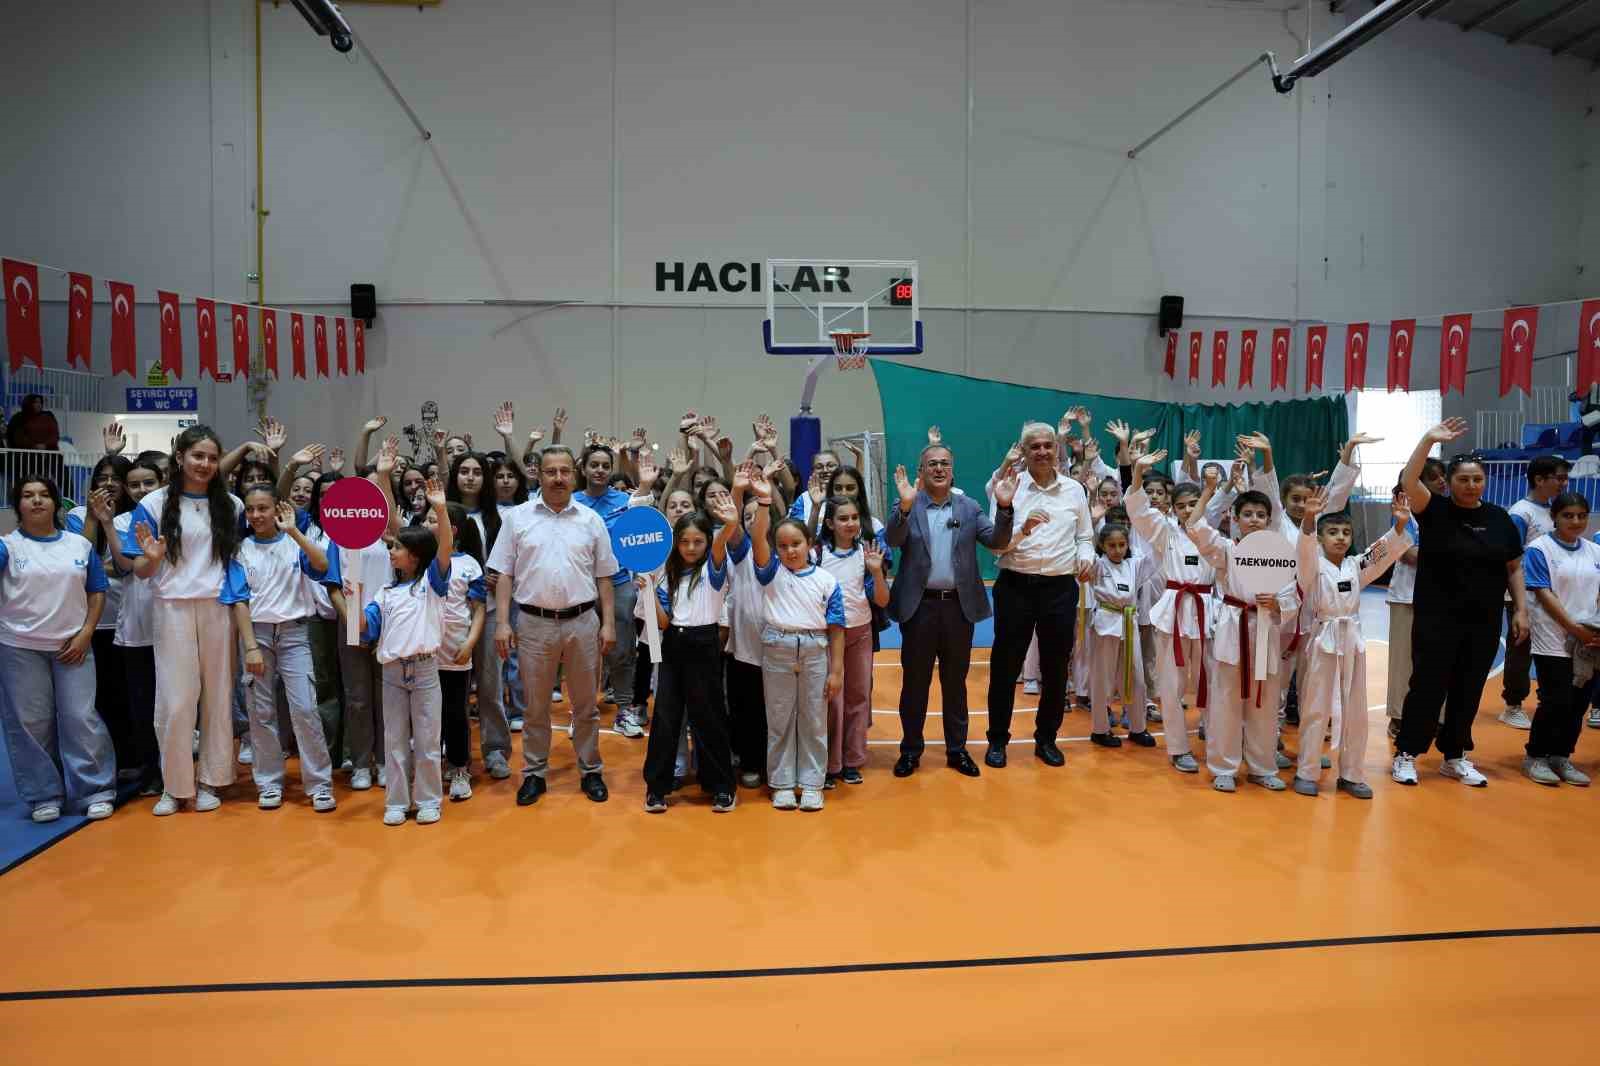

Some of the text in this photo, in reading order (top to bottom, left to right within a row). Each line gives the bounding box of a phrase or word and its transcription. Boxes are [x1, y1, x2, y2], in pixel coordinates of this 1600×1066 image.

[655, 262, 852, 293] HACILAR
[154, 400, 170, 409] WC
[323, 507, 385, 519] VOLEYBOL
[619, 531, 664, 548] YÜZME
[1234, 556, 1297, 569] TAEKWONDO
